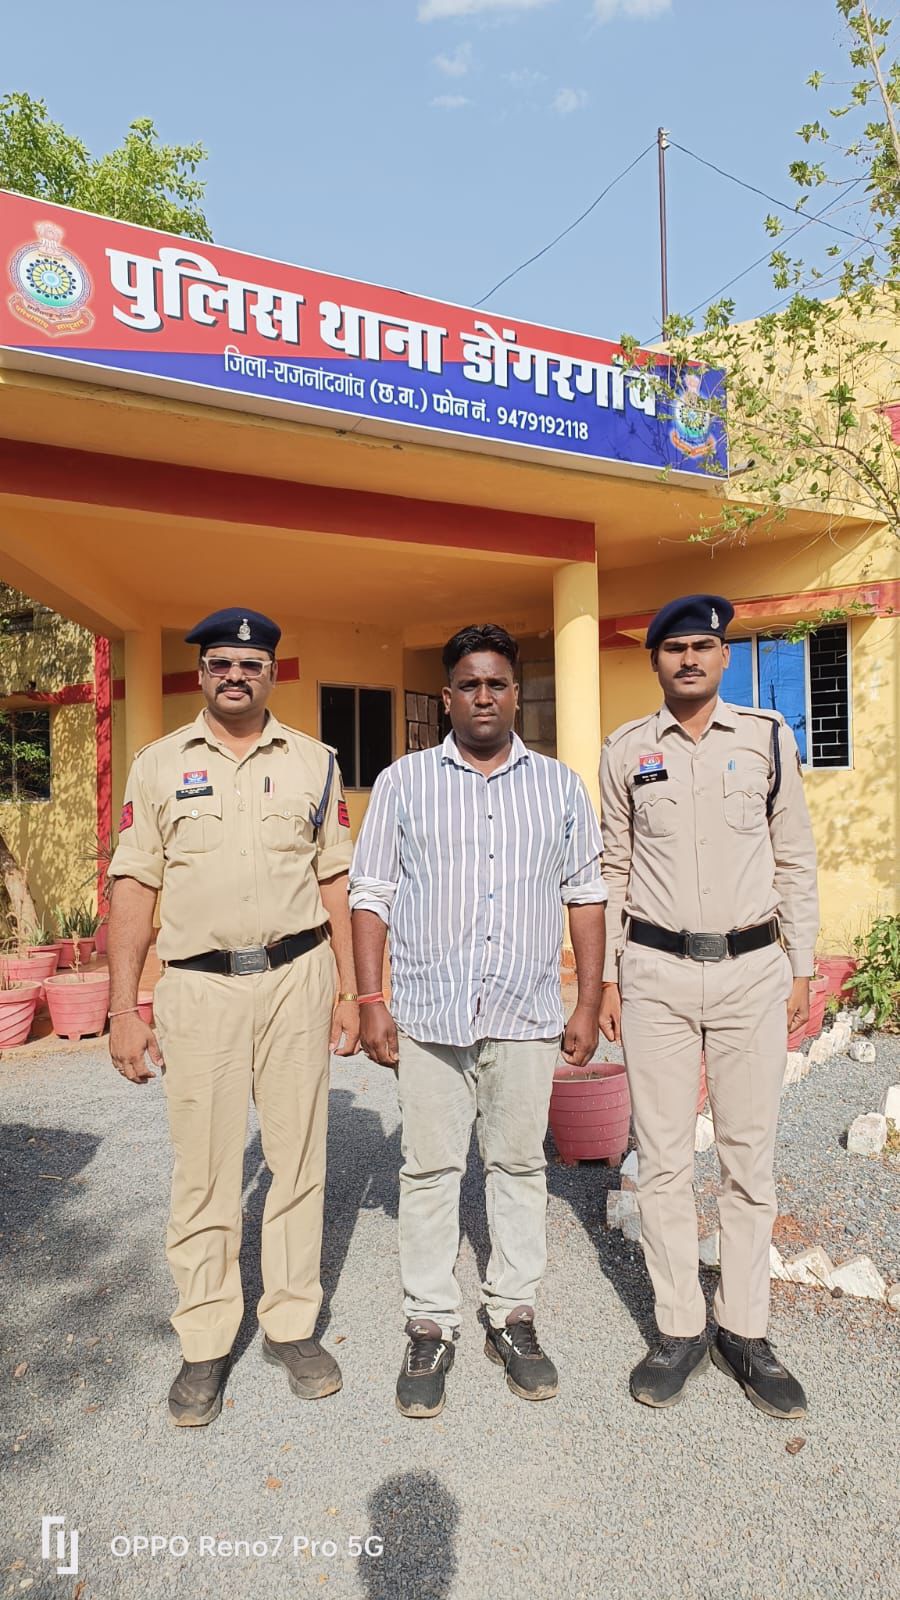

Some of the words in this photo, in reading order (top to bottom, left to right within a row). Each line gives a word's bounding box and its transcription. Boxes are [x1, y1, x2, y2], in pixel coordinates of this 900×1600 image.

[105, 247, 305, 344] पुलिस
[320, 300, 448, 374] थाना
[223, 345, 365, 399] जिला-राजनांदगांव
[369, 378, 428, 413] (छ.ग.)
[432, 389, 469, 418] फोन
[497, 407, 589, 440] 9479192118
